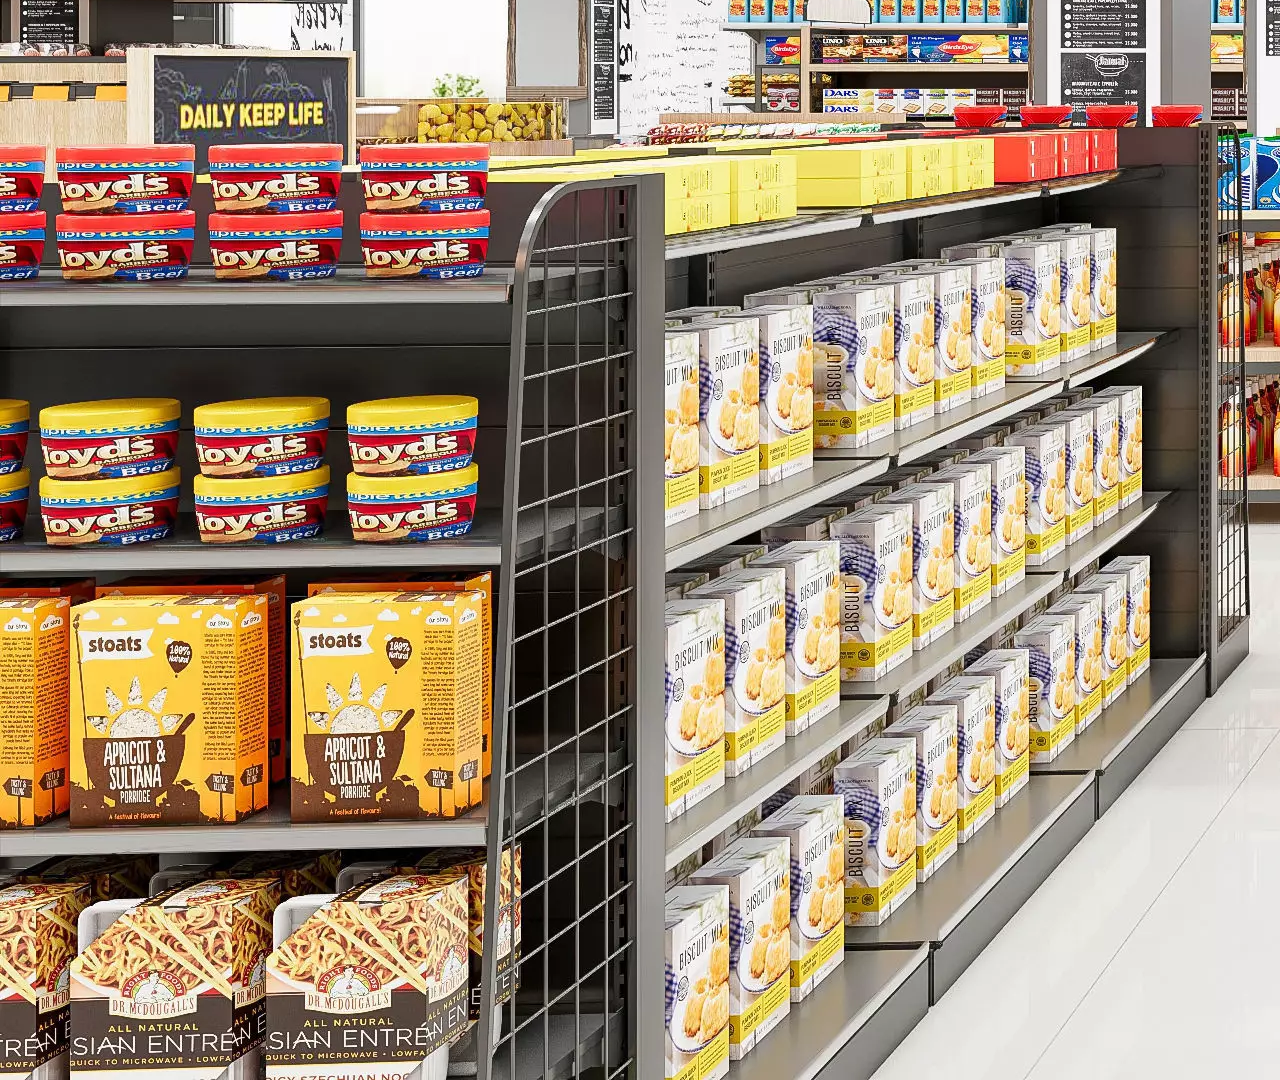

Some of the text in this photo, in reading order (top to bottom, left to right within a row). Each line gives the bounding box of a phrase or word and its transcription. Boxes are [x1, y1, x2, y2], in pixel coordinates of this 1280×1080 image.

[824, 89, 859, 98] DARS
[180, 101, 324, 130] DAILY KEEP LIFE
[824, 105, 859, 113] DARS
[136, 203, 184, 212] Beef
[288, 201, 333, 212] Beef
[440, 200, 482, 211] Beef
[136, 270, 184, 281] Beef
[288, 268, 333, 280] Beef
[440, 266, 482, 279] Beef
[1010, 295, 1024, 336] BISCUIT
[827, 352, 842, 400] BISCUIT
[121, 461, 168, 476] Beef
[275, 460, 320, 474] Beef
[428, 458, 470, 474] Beef
[121, 529, 168, 545] Beef
[275, 527, 320, 543] Beef
[428, 526, 470, 542] Beef
[844, 582, 860, 632] BISCUIT
[741, 606, 767, 635] BISCUIT
[88, 636, 143, 653] stoats
[309, 632, 362, 649] stoats
[389, 641, 410, 652] 100%
[169, 644, 191, 656] 100%
[388, 650, 410, 660] Natural
[674, 641, 704, 672] BISCUIT
[168, 653, 190, 665] Natural
[103, 739, 167, 768] APRICOT &
[324, 735, 386, 762] APRICOT &
[108, 764, 163, 791] SULTANA
[329, 759, 382, 786] SULTANA
[119, 789, 151, 804] PORRIDGE
[340, 785, 371, 799] PORRIDGE
[848, 827, 864, 877] BISCUIT
[679, 938, 708, 971] BISCUIT
[112, 997, 195, 1016] DR. McDOUGALL'S
[307, 992, 390, 1011] DR. McDOUGALL'S
[108, 1023, 199, 1033] ALL NATURAL
[303, 1017, 394, 1027] ALL NATURAL
[70, 1035, 136, 1057] SIAN
[266, 1029, 331, 1051] SIAN
[122, 1056, 184, 1065] MICROWAVE
[317, 1051, 378, 1060] MICROWAVE
